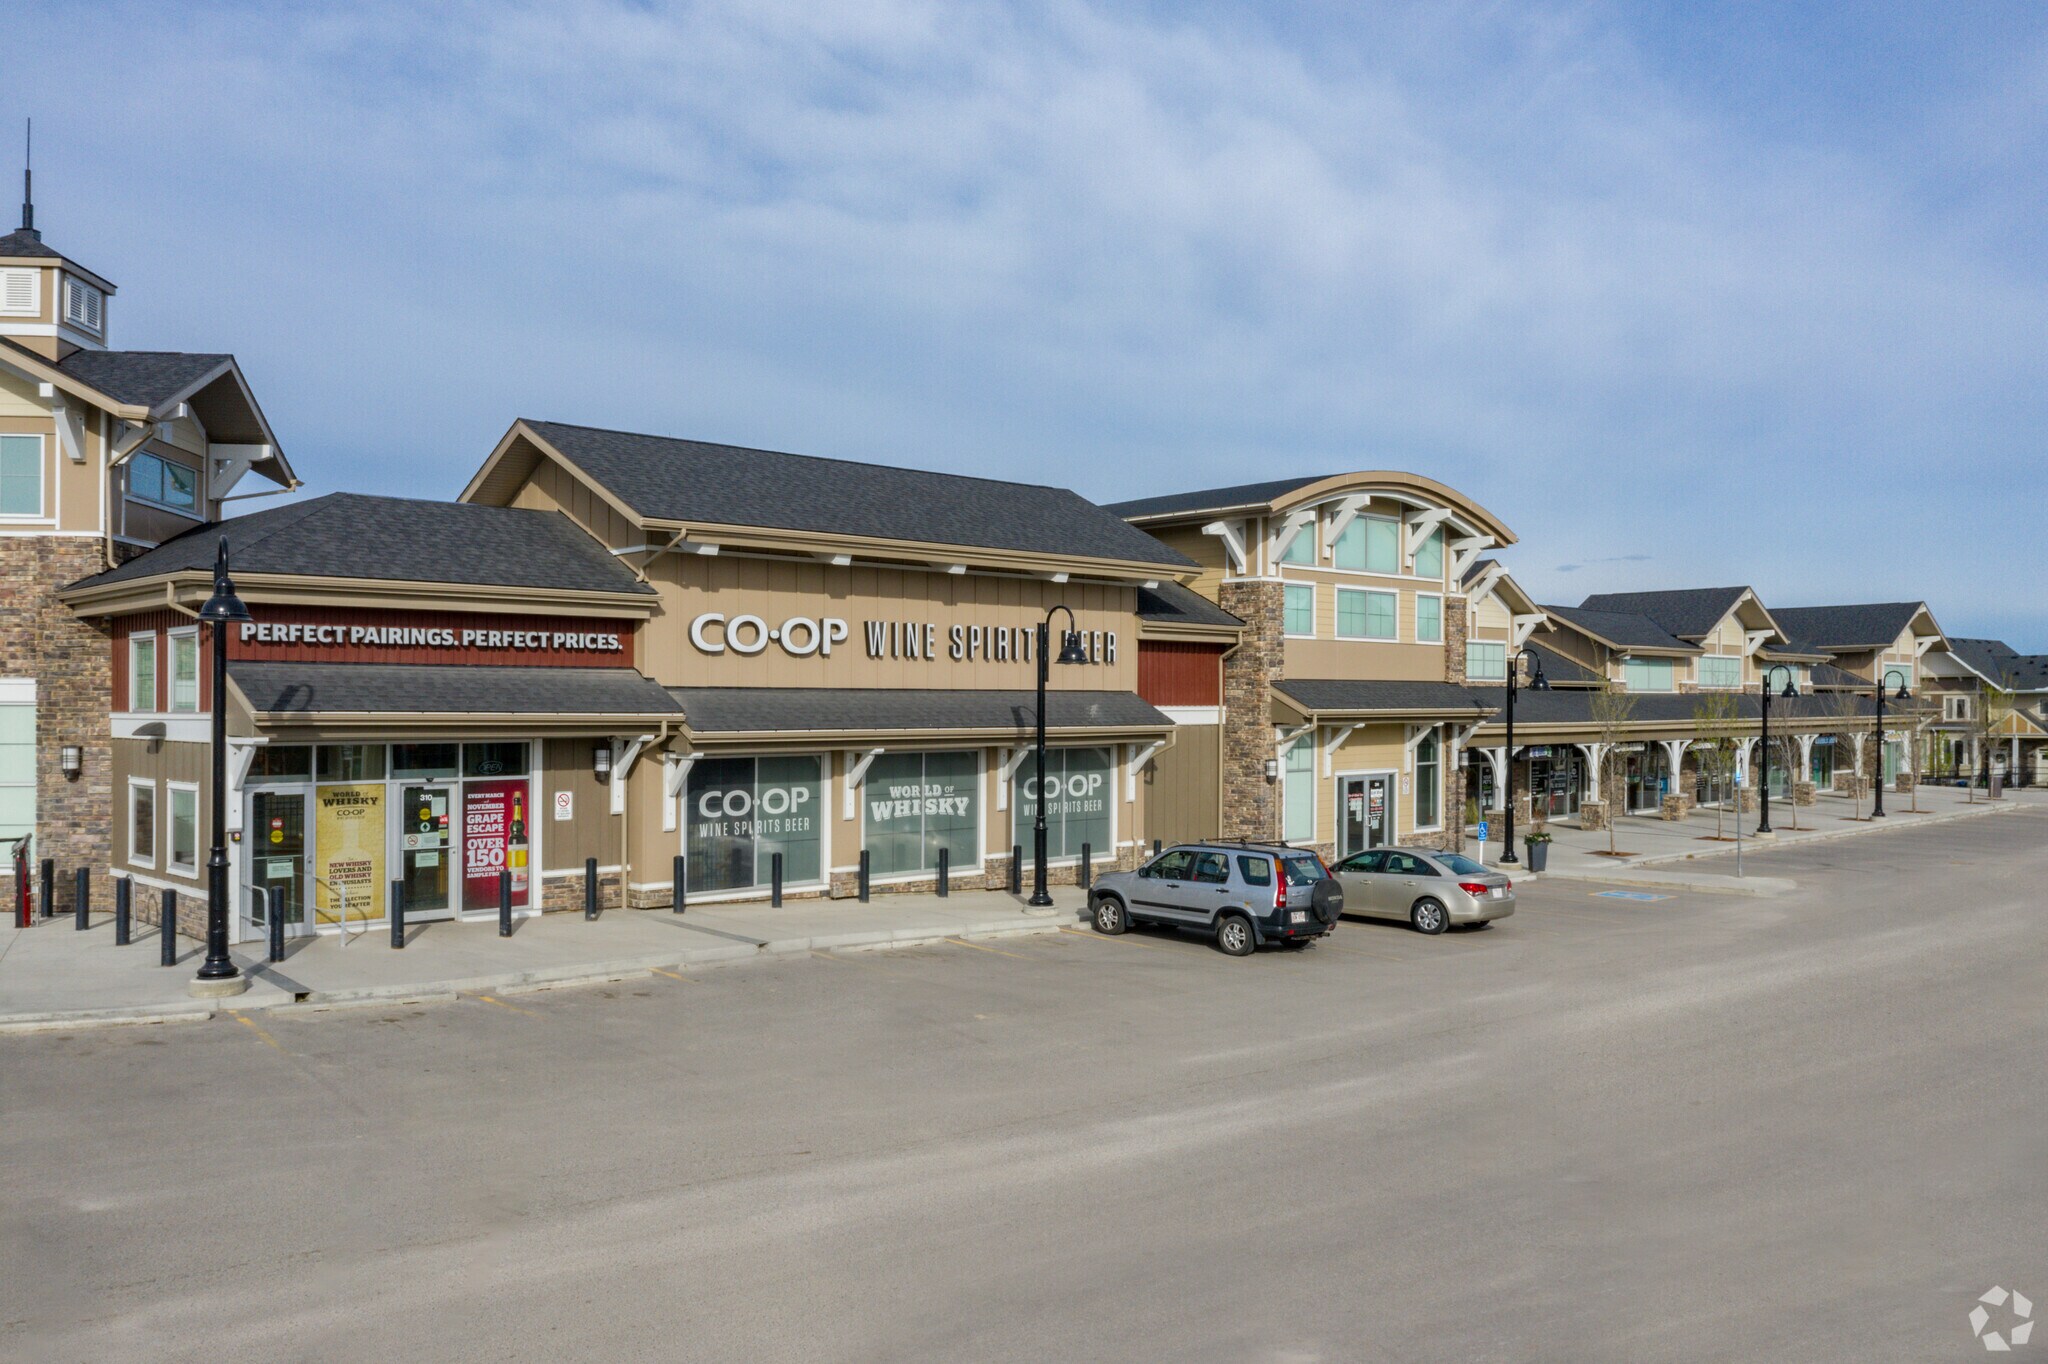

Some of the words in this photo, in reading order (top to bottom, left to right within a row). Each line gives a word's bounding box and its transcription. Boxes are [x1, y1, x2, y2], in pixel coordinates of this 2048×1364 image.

[240, 622, 347, 644] PERFECT
[350, 626, 459, 647] PAIRINGS.
[462, 629, 550, 649] PERFECT
[553, 632, 623, 650] PRICES.
[865, 621, 936, 659] WINE
[950, 625, 1035, 661] SPIRIT
[889, 784, 943, 799] WORLD
[944, 785, 955, 794] OF
[323, 797, 378, 807] WHISKY
[871, 797, 970, 822] WHISKY
[1047, 800, 1082, 815] SPIRITS
[1083, 799, 1102, 812] BEER
[467, 814, 504, 823] GRAPE
[467, 824, 504, 833] ESCAPE
[699, 822, 728, 838] WINE
[734, 818, 780, 836] SPIRITS
[785, 817, 810, 833] BEER
[467, 837, 505, 850] OVER
[467, 848, 504, 867] 150
[328, 867, 356, 875] LOVERS
